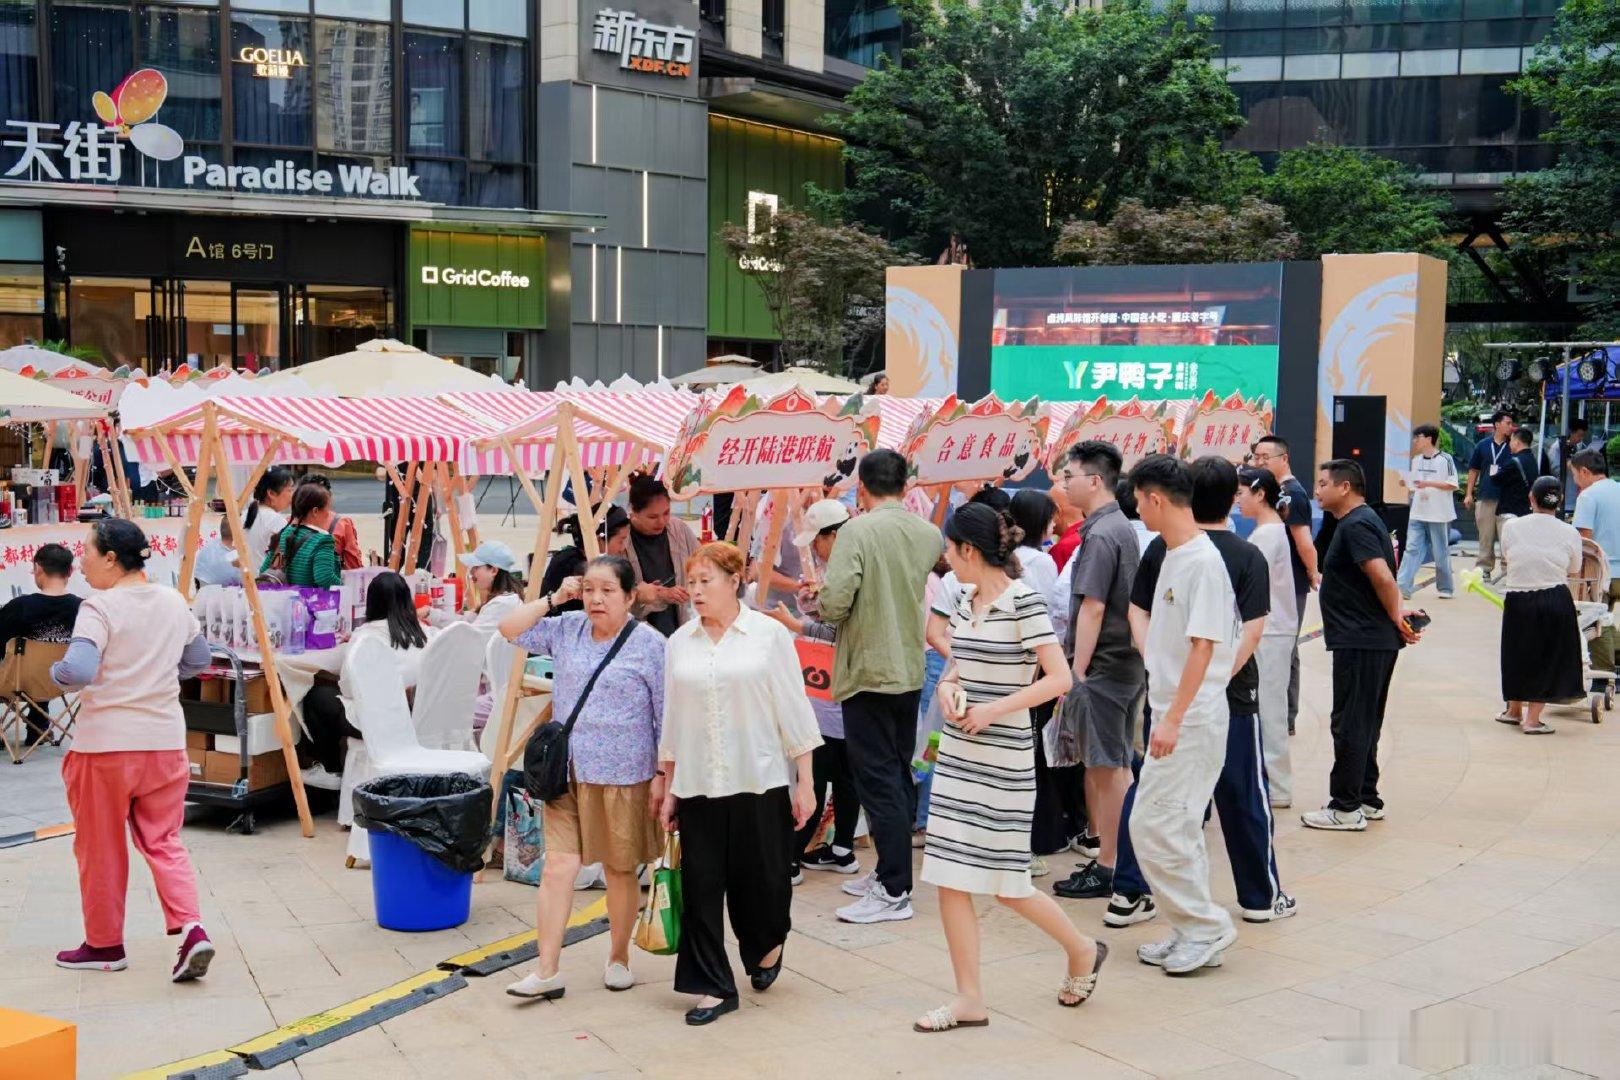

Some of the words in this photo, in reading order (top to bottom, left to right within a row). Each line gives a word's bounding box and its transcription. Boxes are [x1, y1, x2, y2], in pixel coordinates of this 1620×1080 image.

[592, 7, 696, 68] 新东方
[240, 46, 305, 66] GOELIA
[630, 57, 691, 77] XDF.CN
[2, 120, 125, 181] 天街
[183, 155, 333, 193] Paradise
[338, 163, 422, 198] Walk
[186, 236, 225, 260] A馆
[231, 242, 275, 261] 6号门
[1090, 361, 1174, 390] 尹鸭子
[717, 433, 837, 466] 经开陆港联航
[937, 432, 1017, 463] 合意食品
